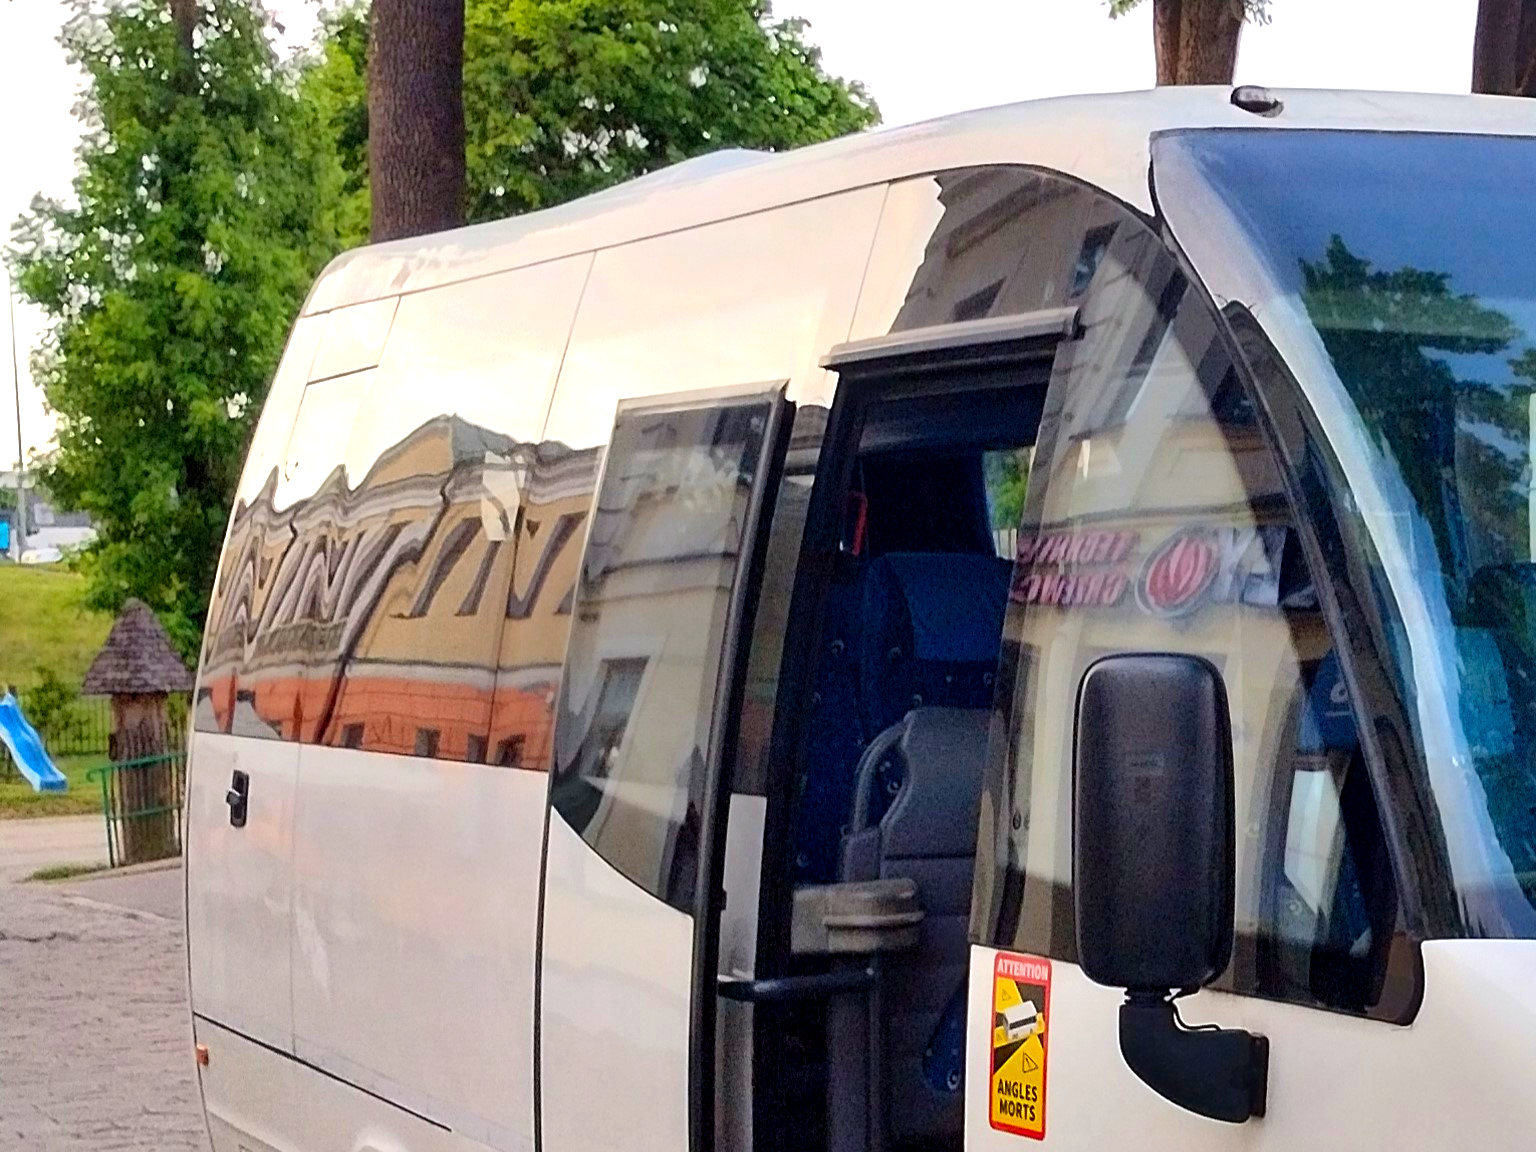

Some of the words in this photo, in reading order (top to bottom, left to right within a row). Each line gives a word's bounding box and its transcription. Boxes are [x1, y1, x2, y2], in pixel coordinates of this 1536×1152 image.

[997, 958, 1049, 981] ATTENTION
[997, 1078, 1038, 1102] ANGLES
[999, 1098, 1036, 1122] MORTS
